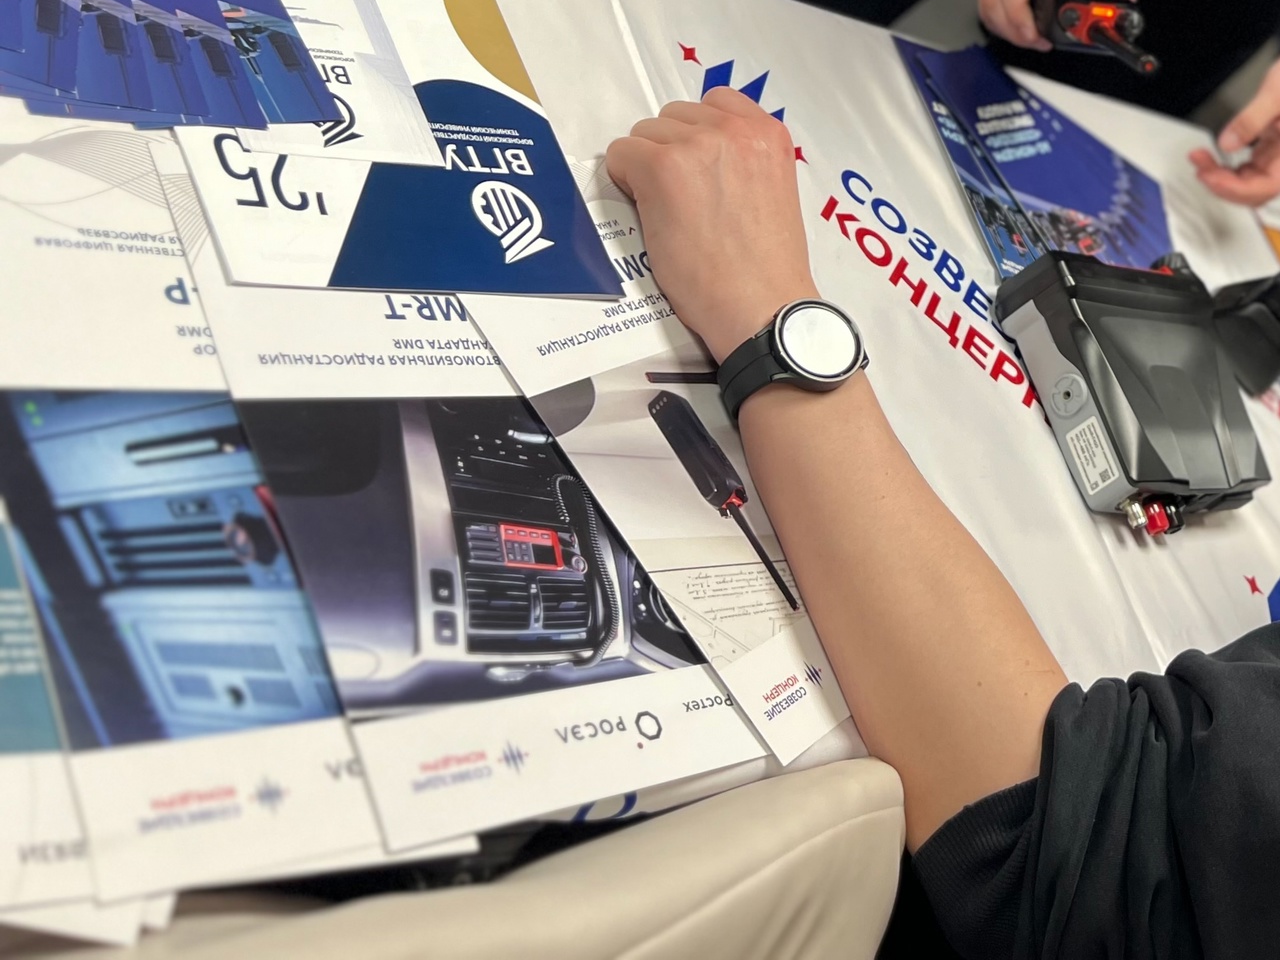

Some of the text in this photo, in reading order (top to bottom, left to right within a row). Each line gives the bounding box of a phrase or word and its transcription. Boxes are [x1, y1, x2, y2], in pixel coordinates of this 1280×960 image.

[470, 126, 519, 136] ТЕХНИЧЕСКИЙ
[483, 135, 534, 145] ВОРОНЕЖСКИЙ
[445, 144, 534, 175] ВГТУ
[77, 228, 165, 244] РАДИОСВЯЗЬ
[34, 237, 114, 251] ЦИФРОВАЯ
[602, 304, 624, 318] DMR
[392, 339, 423, 350] DMR
[536, 322, 622, 357] РАДИОСТАНЦИЯ
[258, 353, 384, 365] РАДИОСТАНЦИЯ
[762, 674, 799, 703] КОНЦЕРН
[683, 693, 733, 712] Ростех
[764, 687, 807, 721] СОЗВЕЗДИЕ
